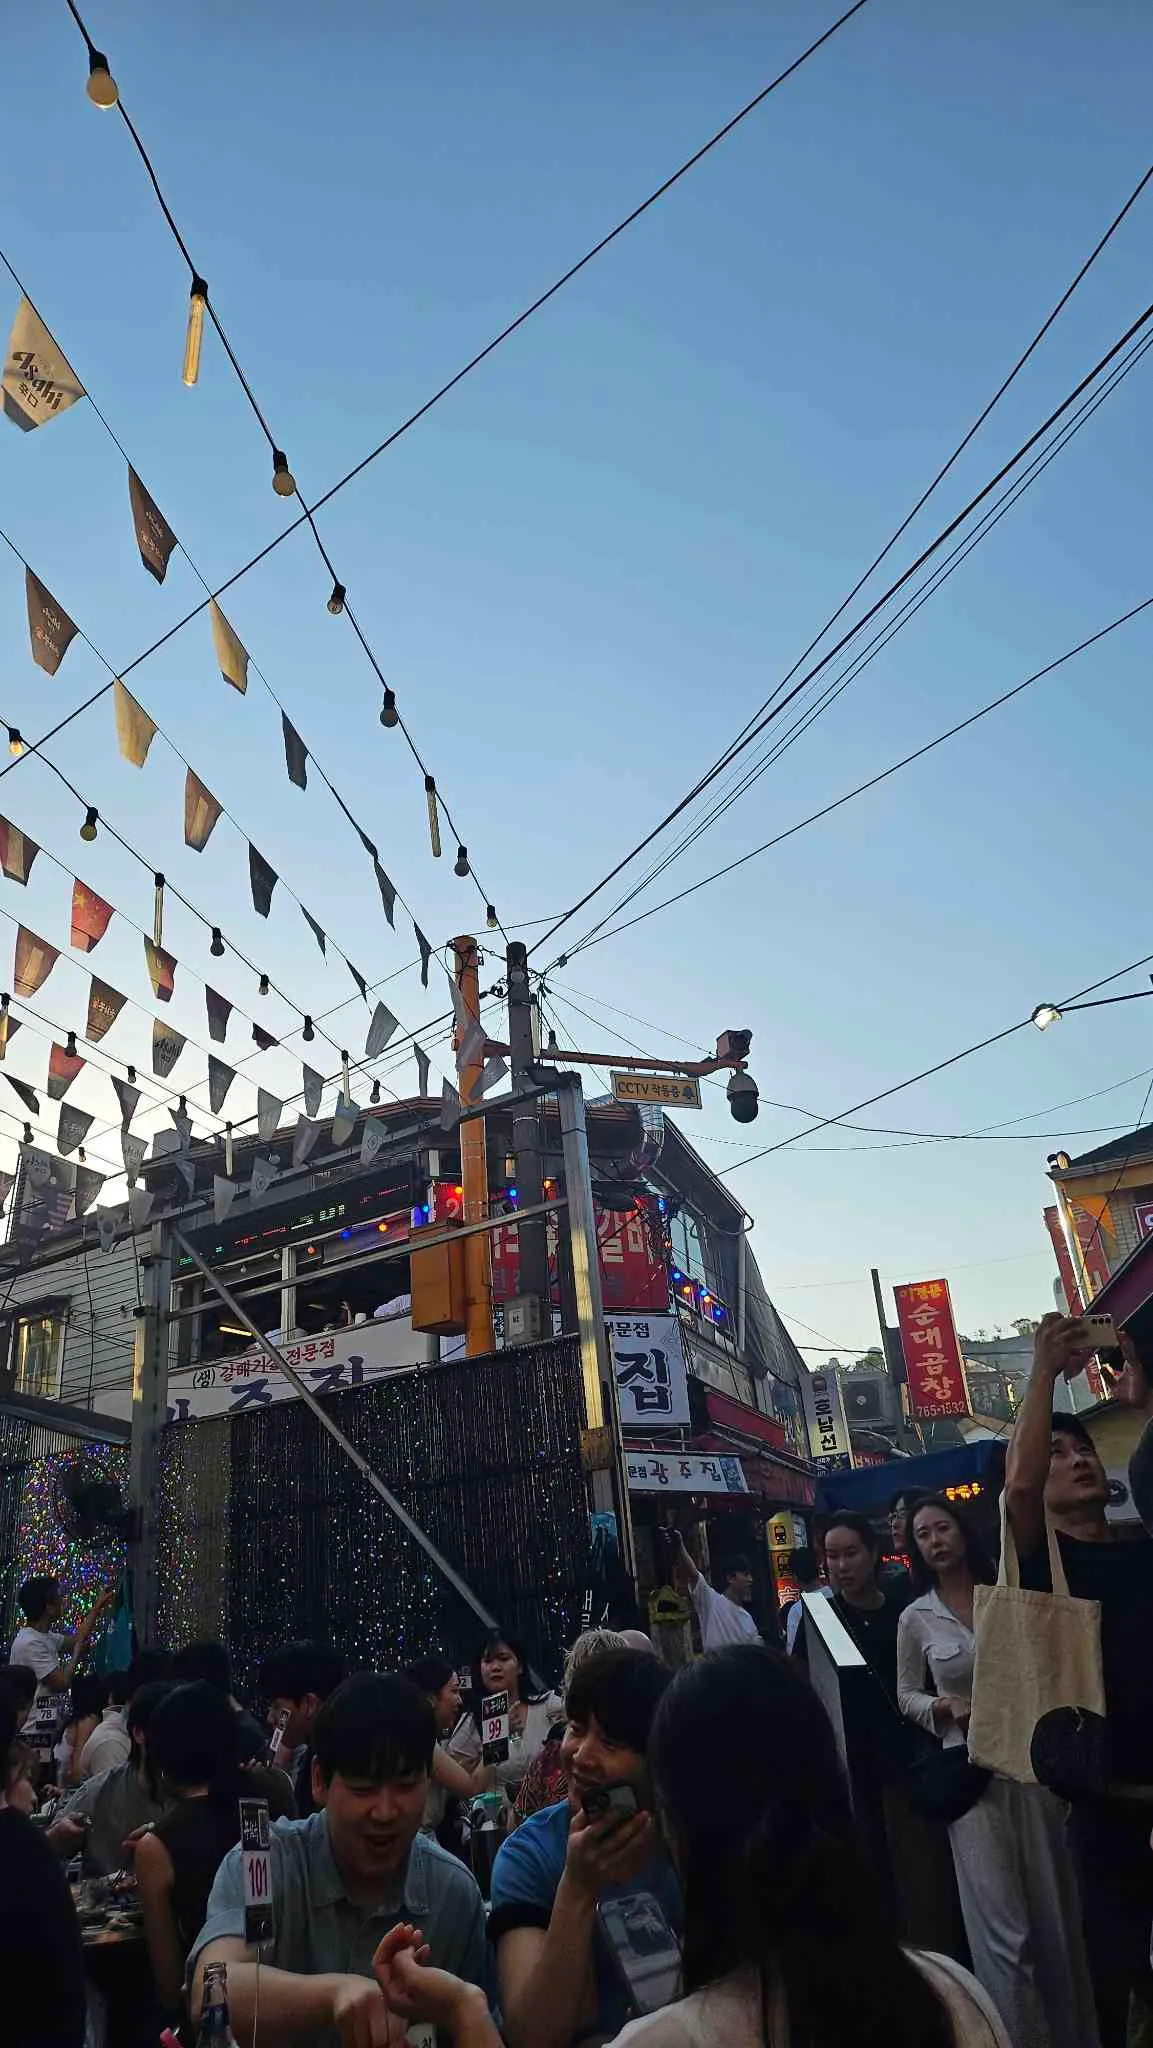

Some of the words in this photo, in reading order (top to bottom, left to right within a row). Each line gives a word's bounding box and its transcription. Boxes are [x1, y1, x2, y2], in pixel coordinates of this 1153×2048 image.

[12, 351, 63, 410] Asahi
[618, 1082, 649, 1095] CCTV
[286, 1338, 336, 1366] 전문점
[908, 1303, 955, 1401] 순대곱창
[614, 1349, 672, 1414] 집
[489, 1719, 502, 1740] 99
[248, 1858, 268, 1897] 101
